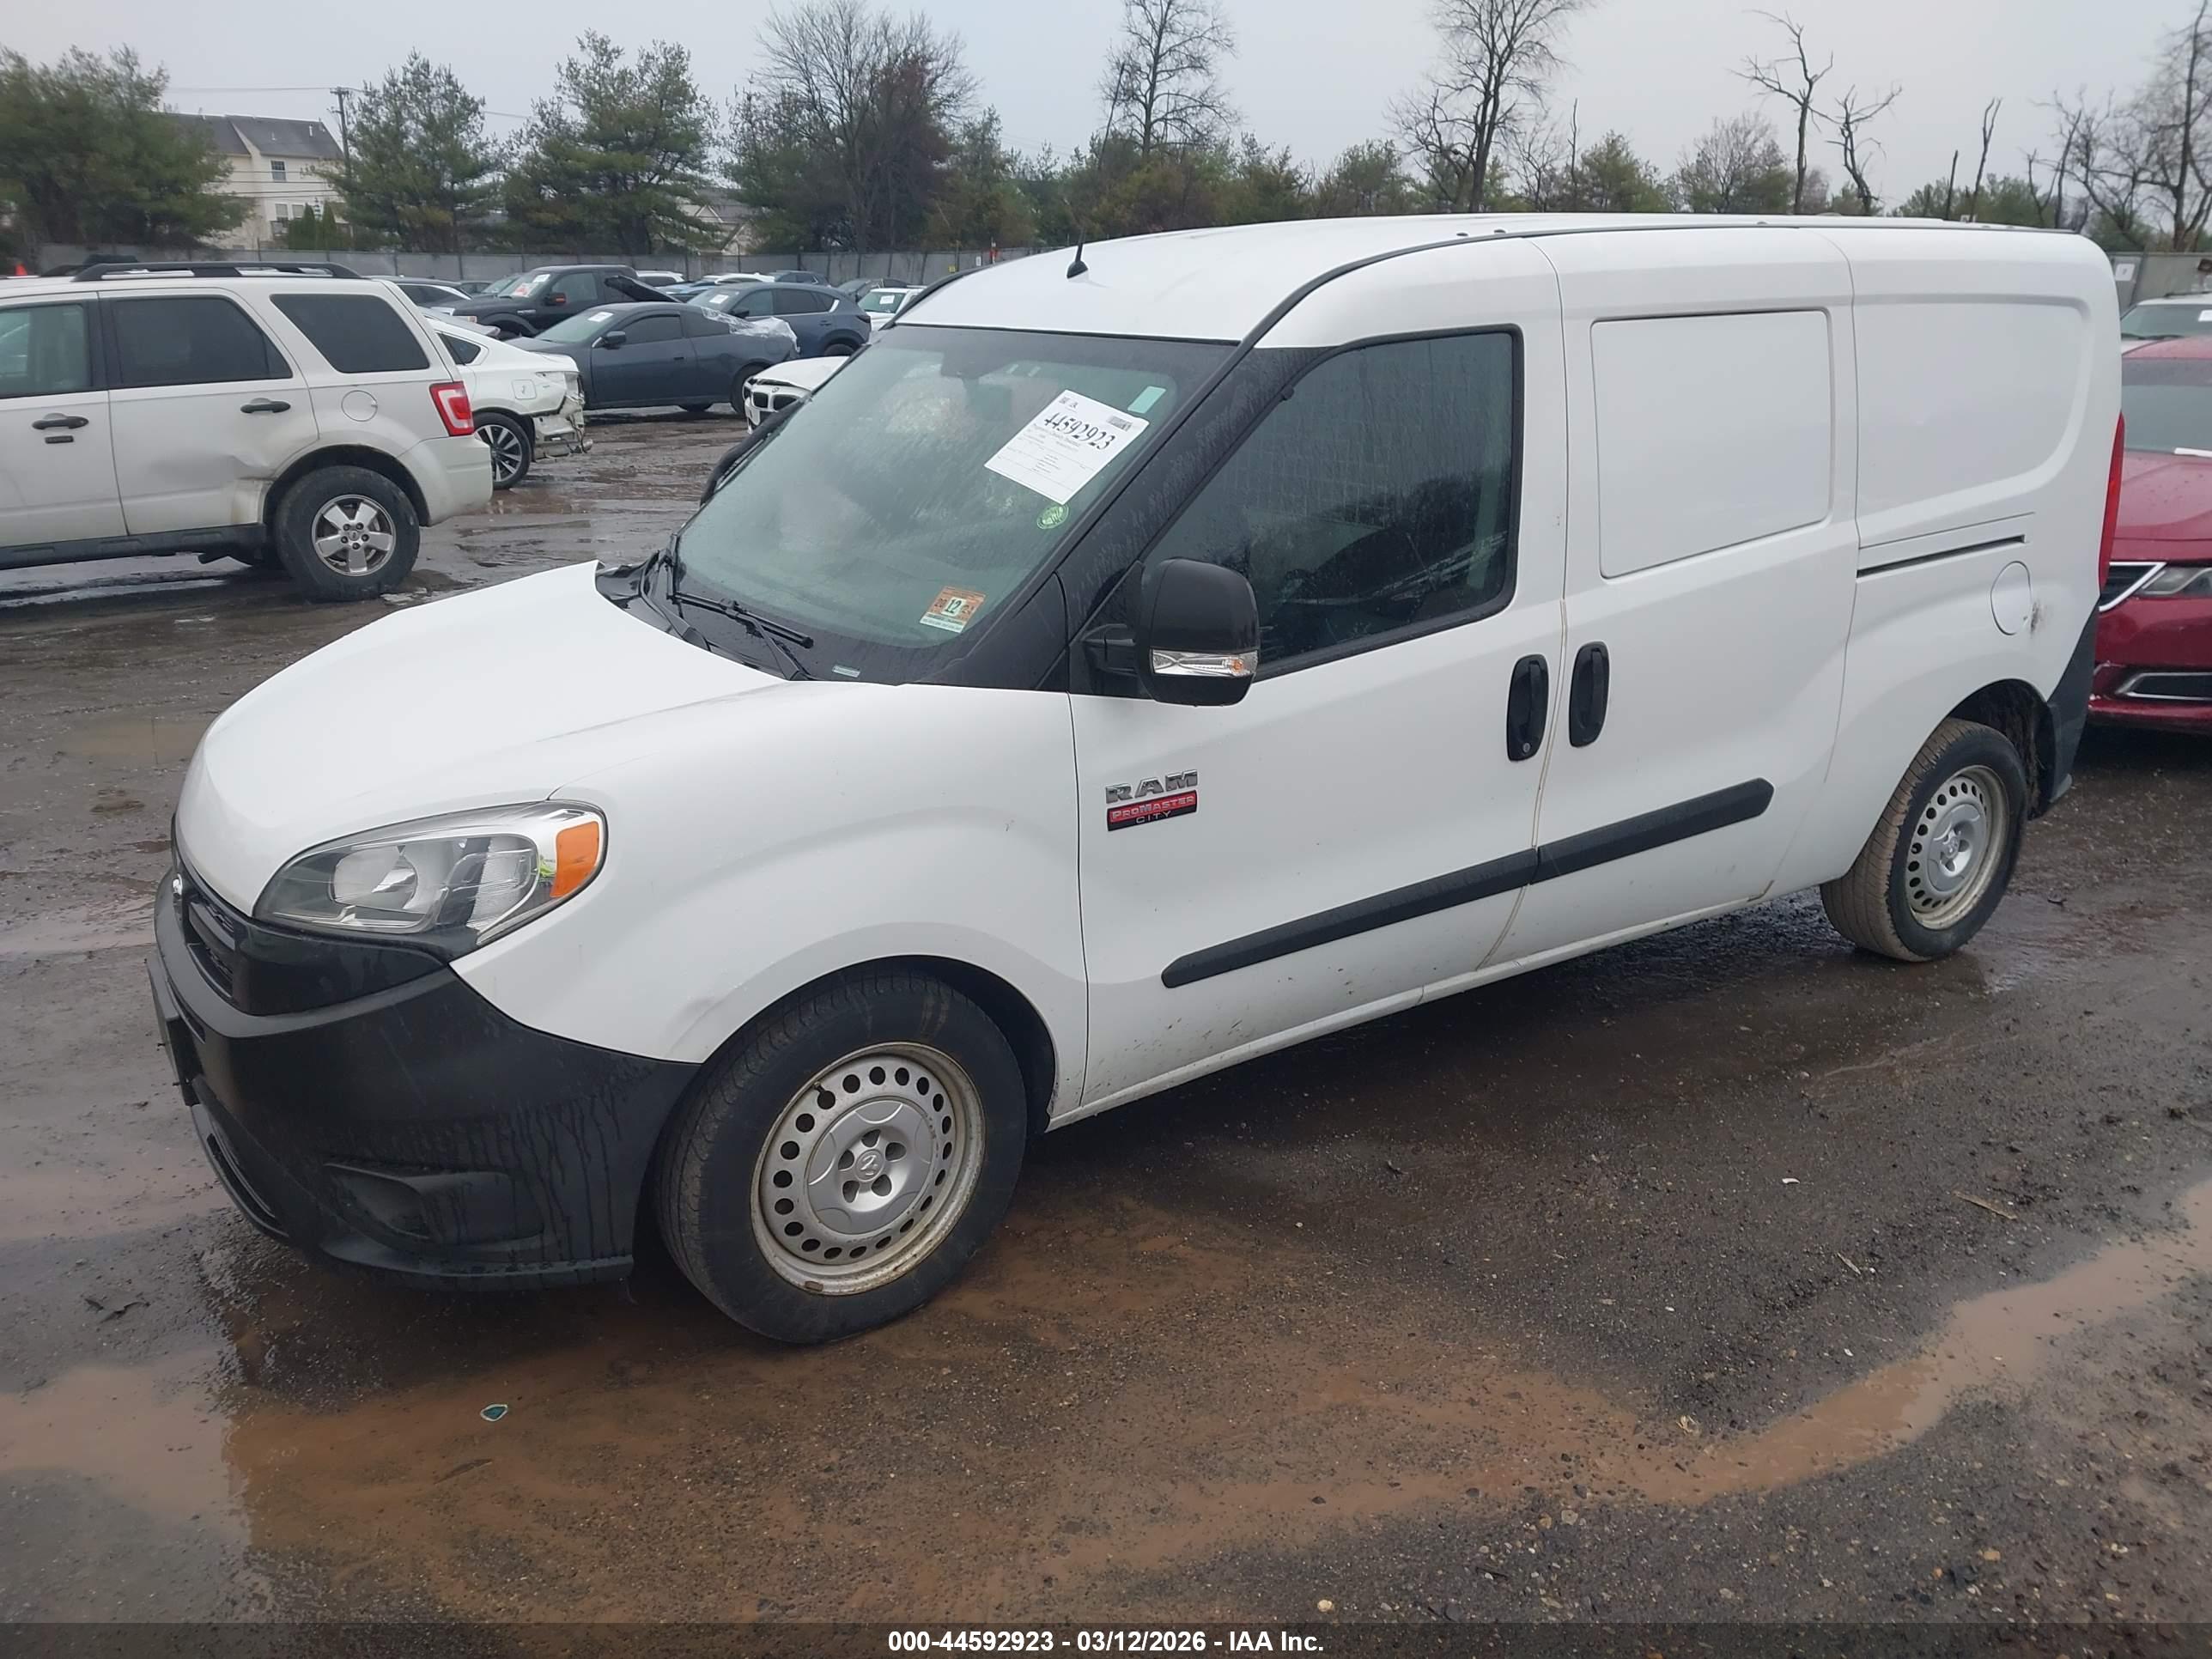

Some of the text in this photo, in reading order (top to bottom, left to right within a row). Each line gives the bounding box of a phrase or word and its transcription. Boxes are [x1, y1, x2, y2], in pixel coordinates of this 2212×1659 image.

[1044, 411, 1118, 450] 44592923
[945, 599, 963, 614] 12
[1105, 769, 1198, 804] RAM
[1136, 810, 1171, 824] CITY
